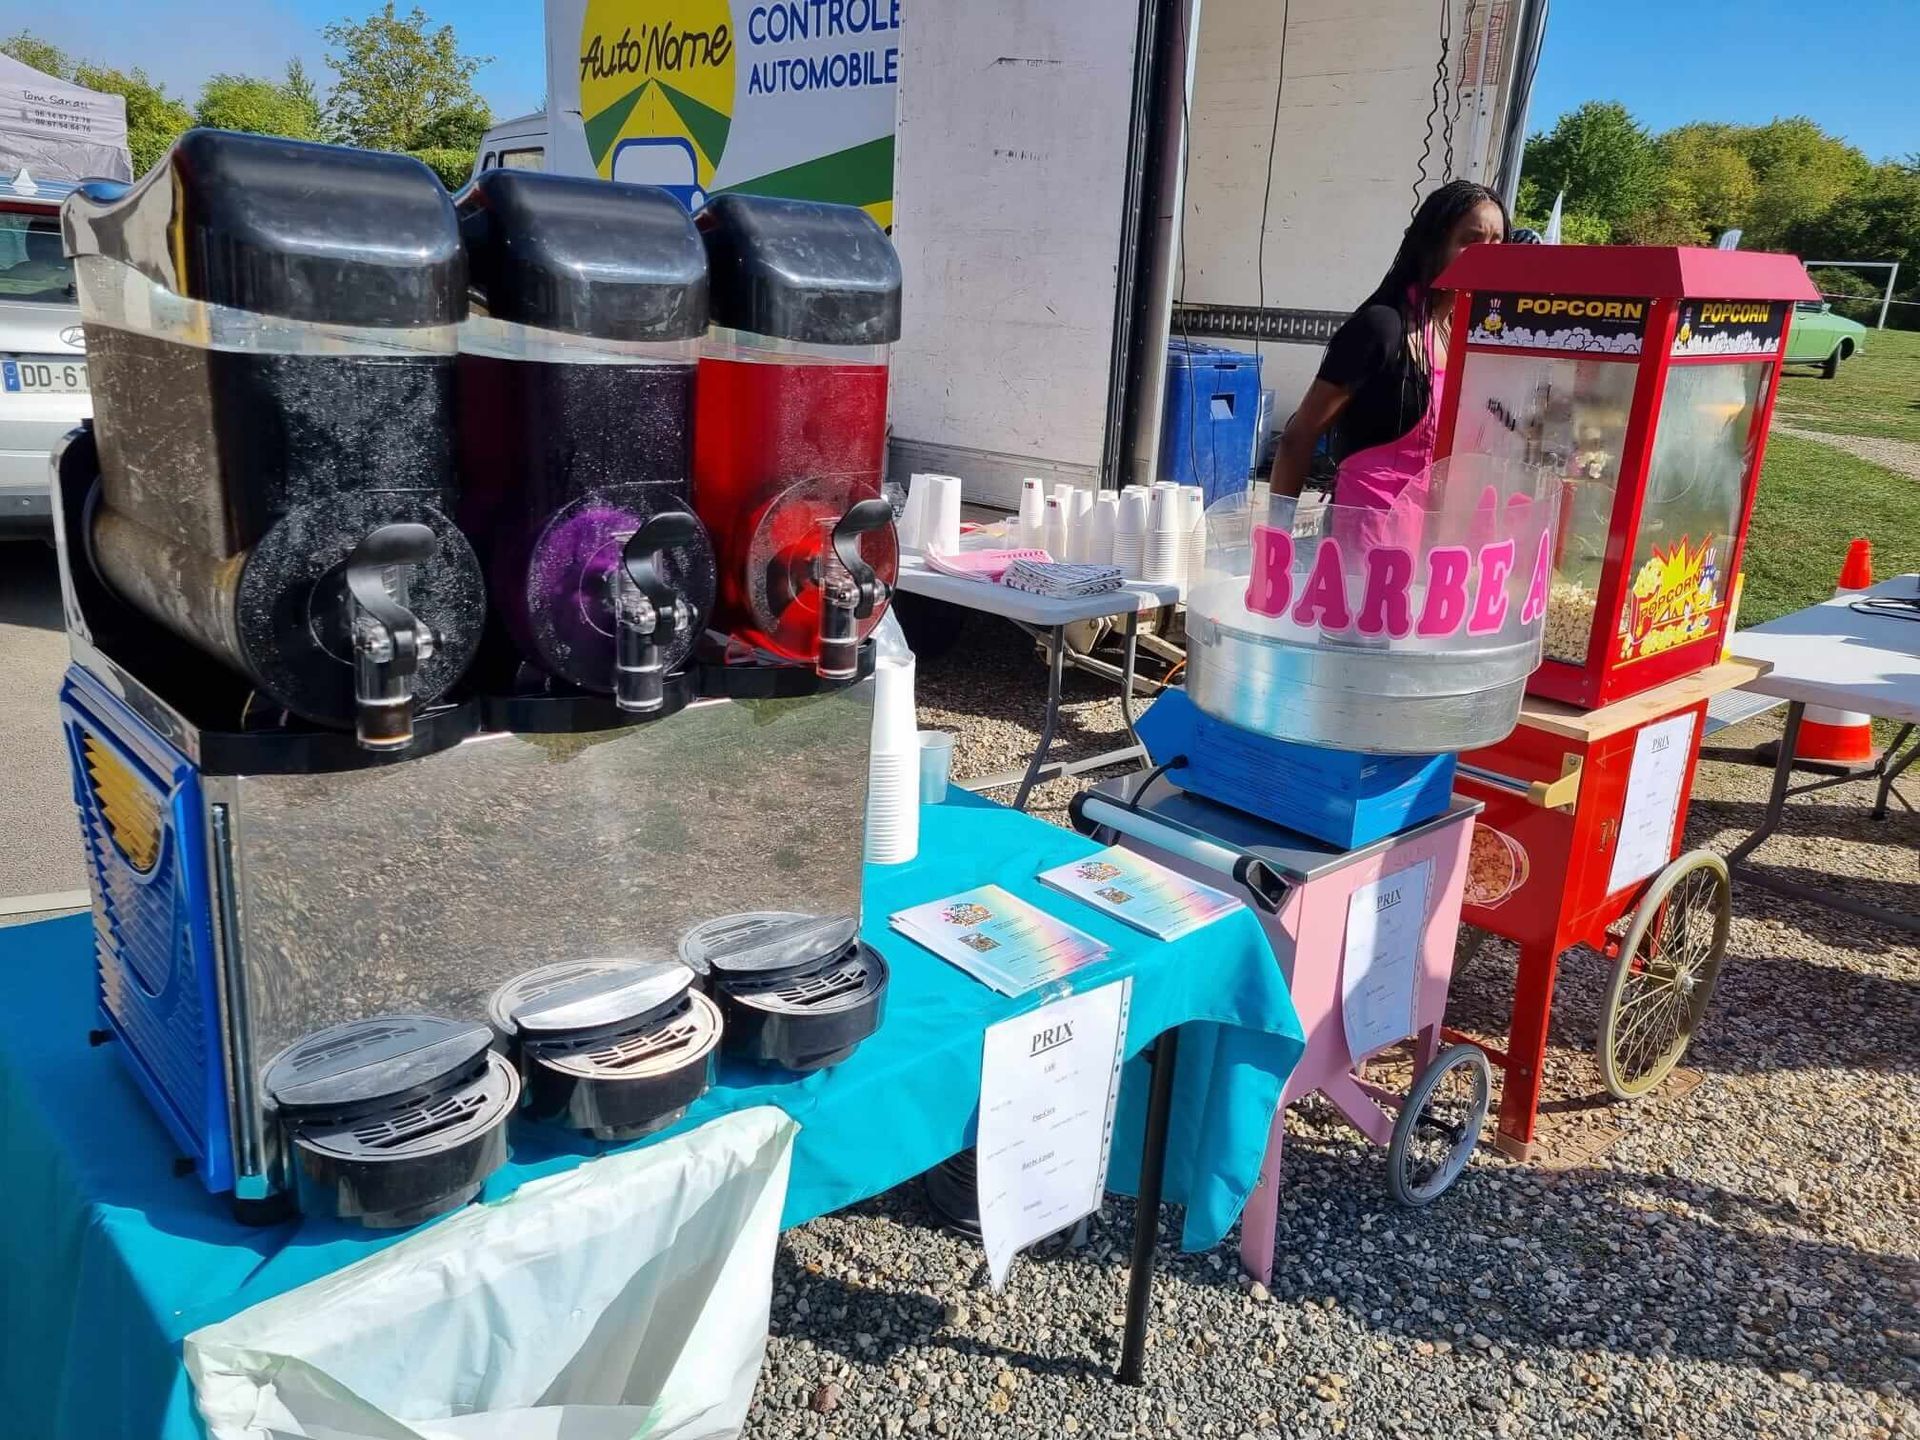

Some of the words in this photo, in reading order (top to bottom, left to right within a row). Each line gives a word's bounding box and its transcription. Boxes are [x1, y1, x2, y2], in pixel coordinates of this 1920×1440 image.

[581, 21, 732, 82] Auto'Nome
[749, 48, 898, 95] AUTOMOBILE
[1517, 298, 1643, 319] POPCORN
[1699, 303, 1771, 324] POPCORN
[1244, 526, 1515, 639] BARBE
[1640, 571, 1701, 619] POPCORN
[1652, 735, 1670, 750] PRIX
[1376, 888, 1401, 910] PRIX
[1031, 1020, 1074, 1053] PRIX
